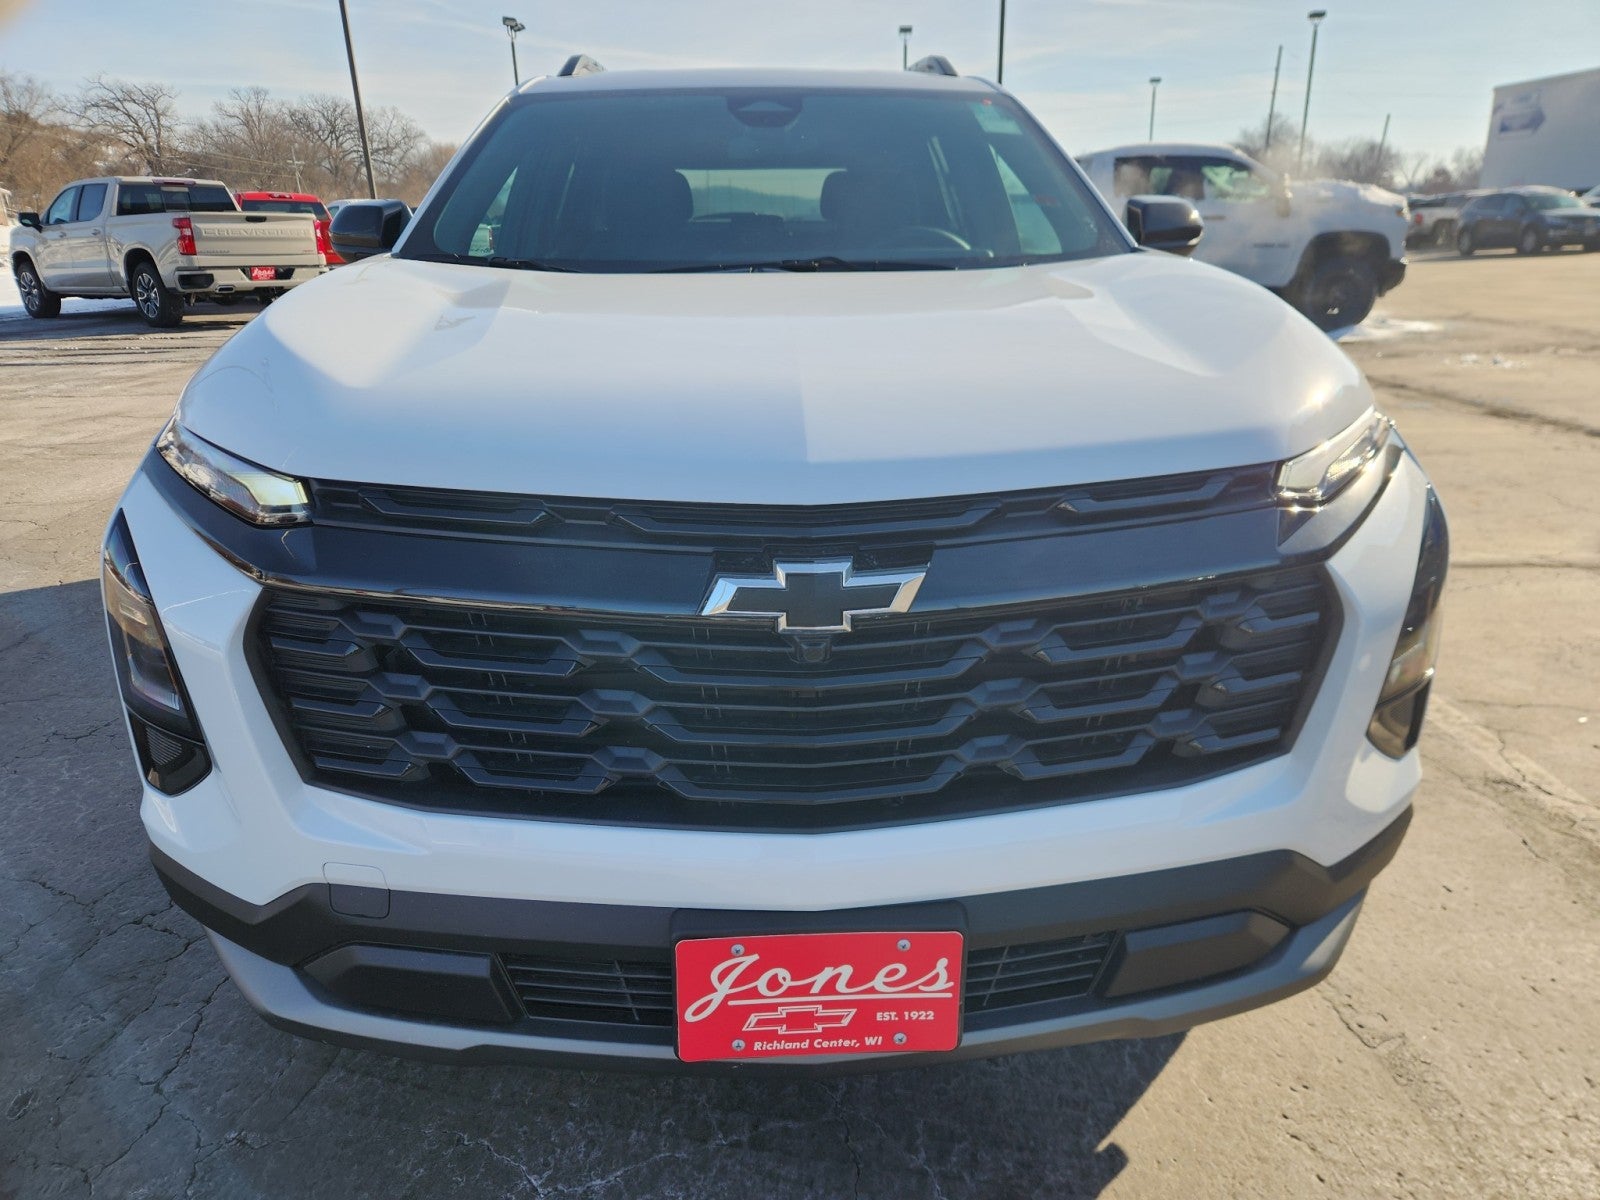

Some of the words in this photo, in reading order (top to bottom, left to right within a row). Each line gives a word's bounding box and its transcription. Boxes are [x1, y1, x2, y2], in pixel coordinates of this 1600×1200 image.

[684, 953, 954, 1022] Jones
[876, 1011, 899, 1021] EST.
[904, 1010, 935, 1020] 1922
[753, 1039, 809, 1051] Richland
[813, 1038, 860, 1048] Center,
[864, 1036, 883, 1046] WI
